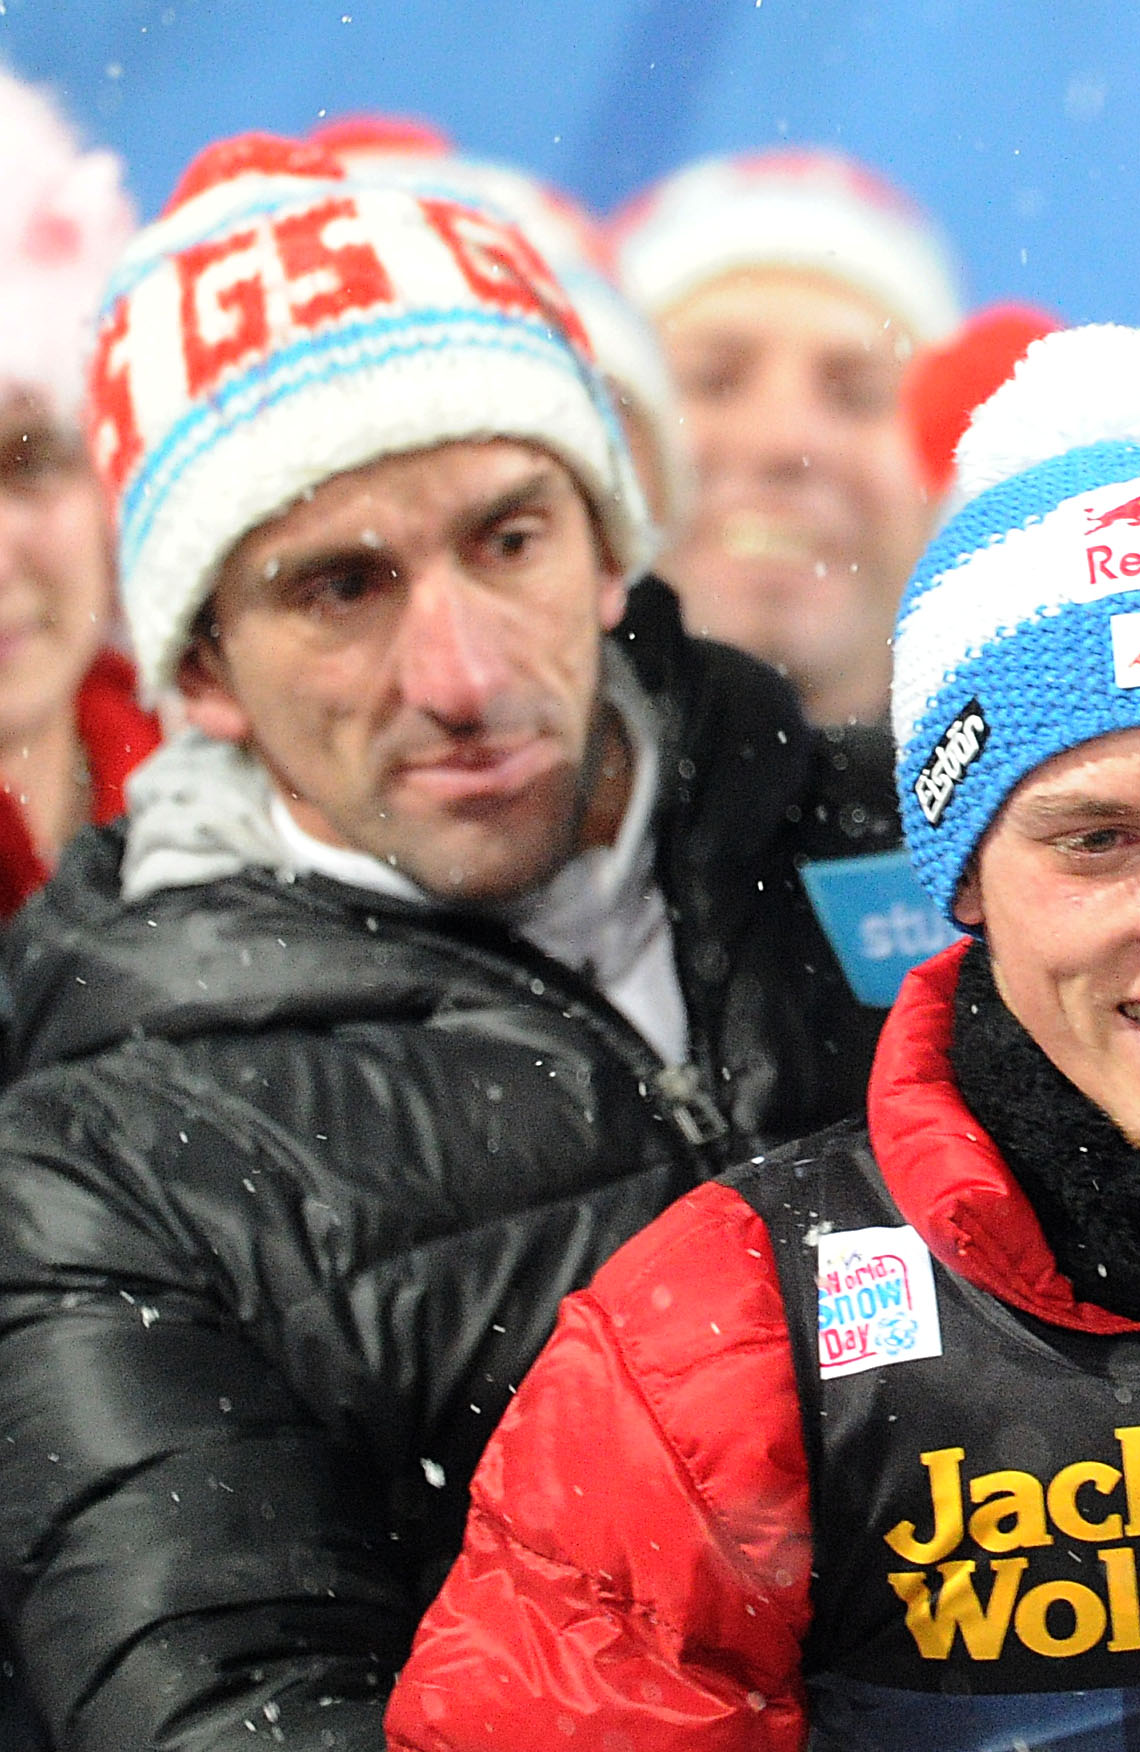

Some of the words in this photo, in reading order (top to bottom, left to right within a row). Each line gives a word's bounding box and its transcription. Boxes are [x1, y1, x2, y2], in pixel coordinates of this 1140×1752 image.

[915, 714, 984, 824] Eisbär
[826, 1258, 888, 1296] World
[823, 1323, 870, 1361] Day
